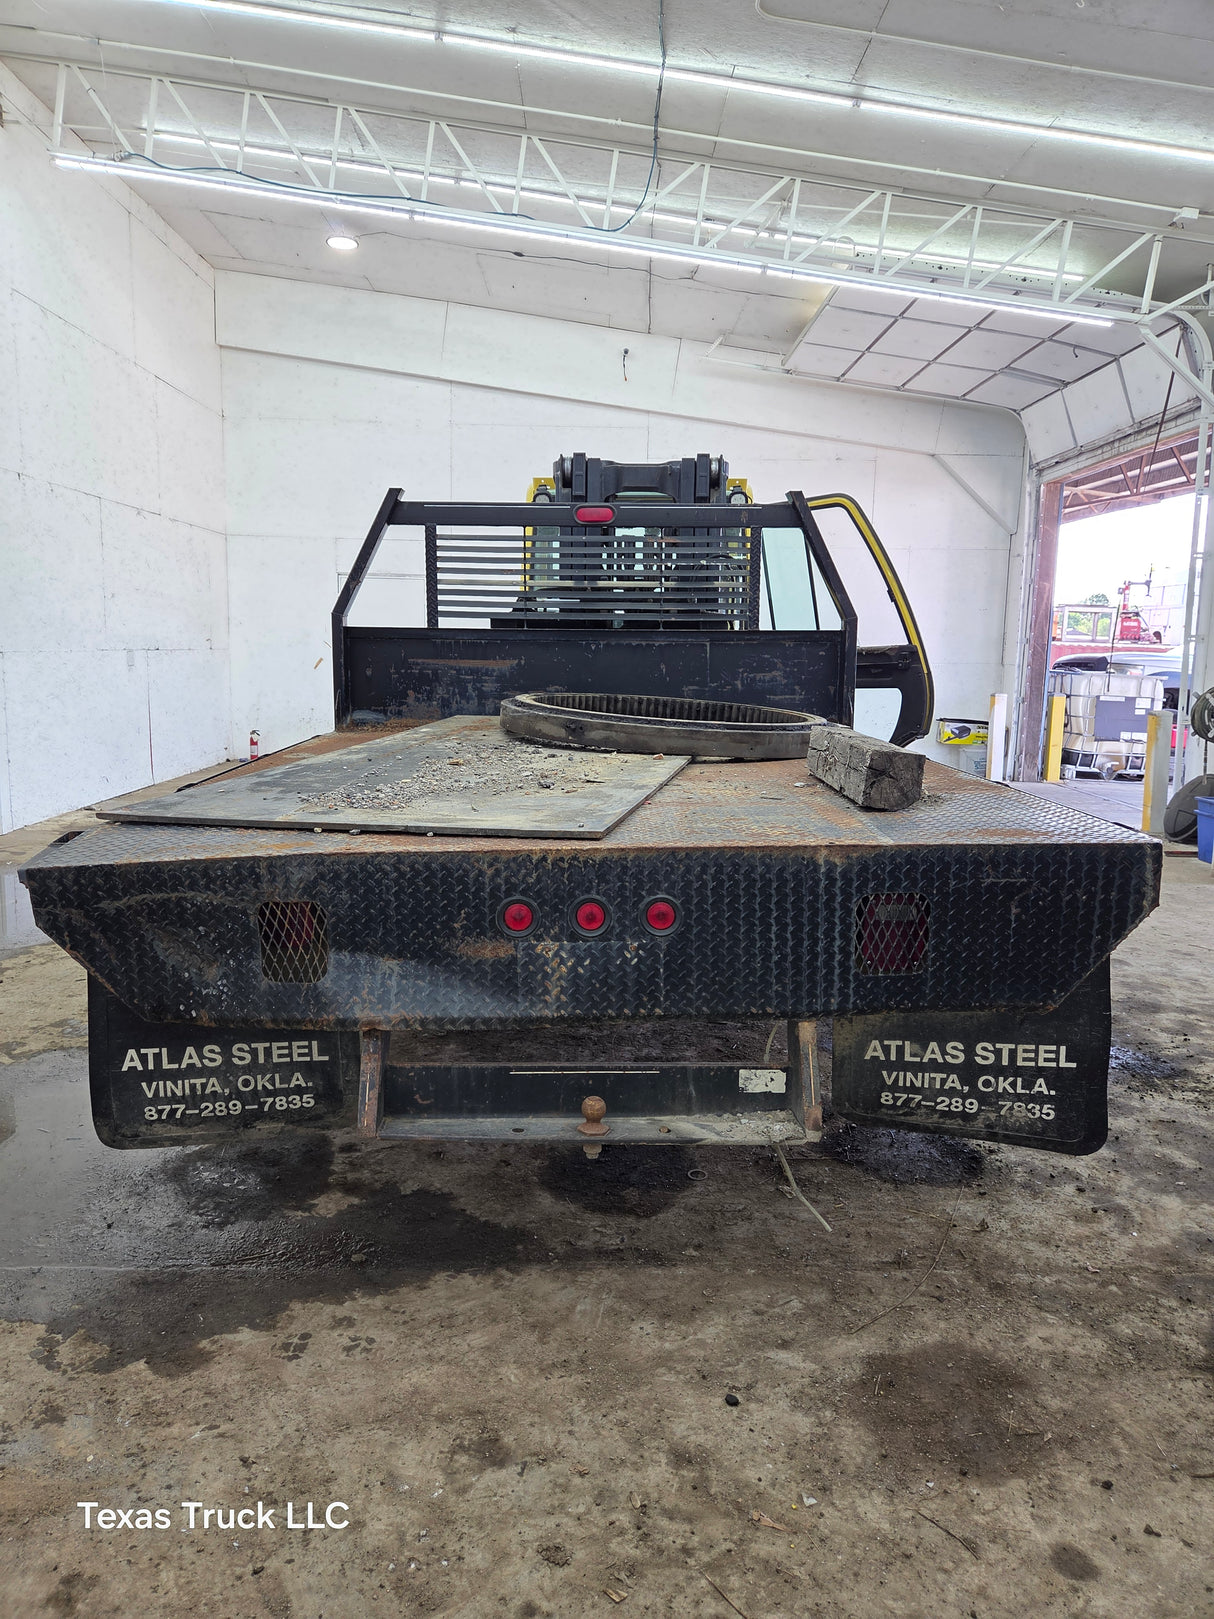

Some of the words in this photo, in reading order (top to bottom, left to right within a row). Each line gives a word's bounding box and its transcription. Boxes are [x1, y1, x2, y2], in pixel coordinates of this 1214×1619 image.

[121, 1044, 223, 1072] ATLAS
[232, 1041, 329, 1065] STEEL
[864, 1040, 965, 1064] ATLAS
[975, 1042, 1077, 1068] STEEL
[141, 1077, 230, 1099] VINITA,
[237, 1072, 313, 1092] OKLA.
[881, 1071, 969, 1093] VINITA,
[978, 1075, 1056, 1095] OKLA.
[144, 1094, 315, 1121] 877-289-7835
